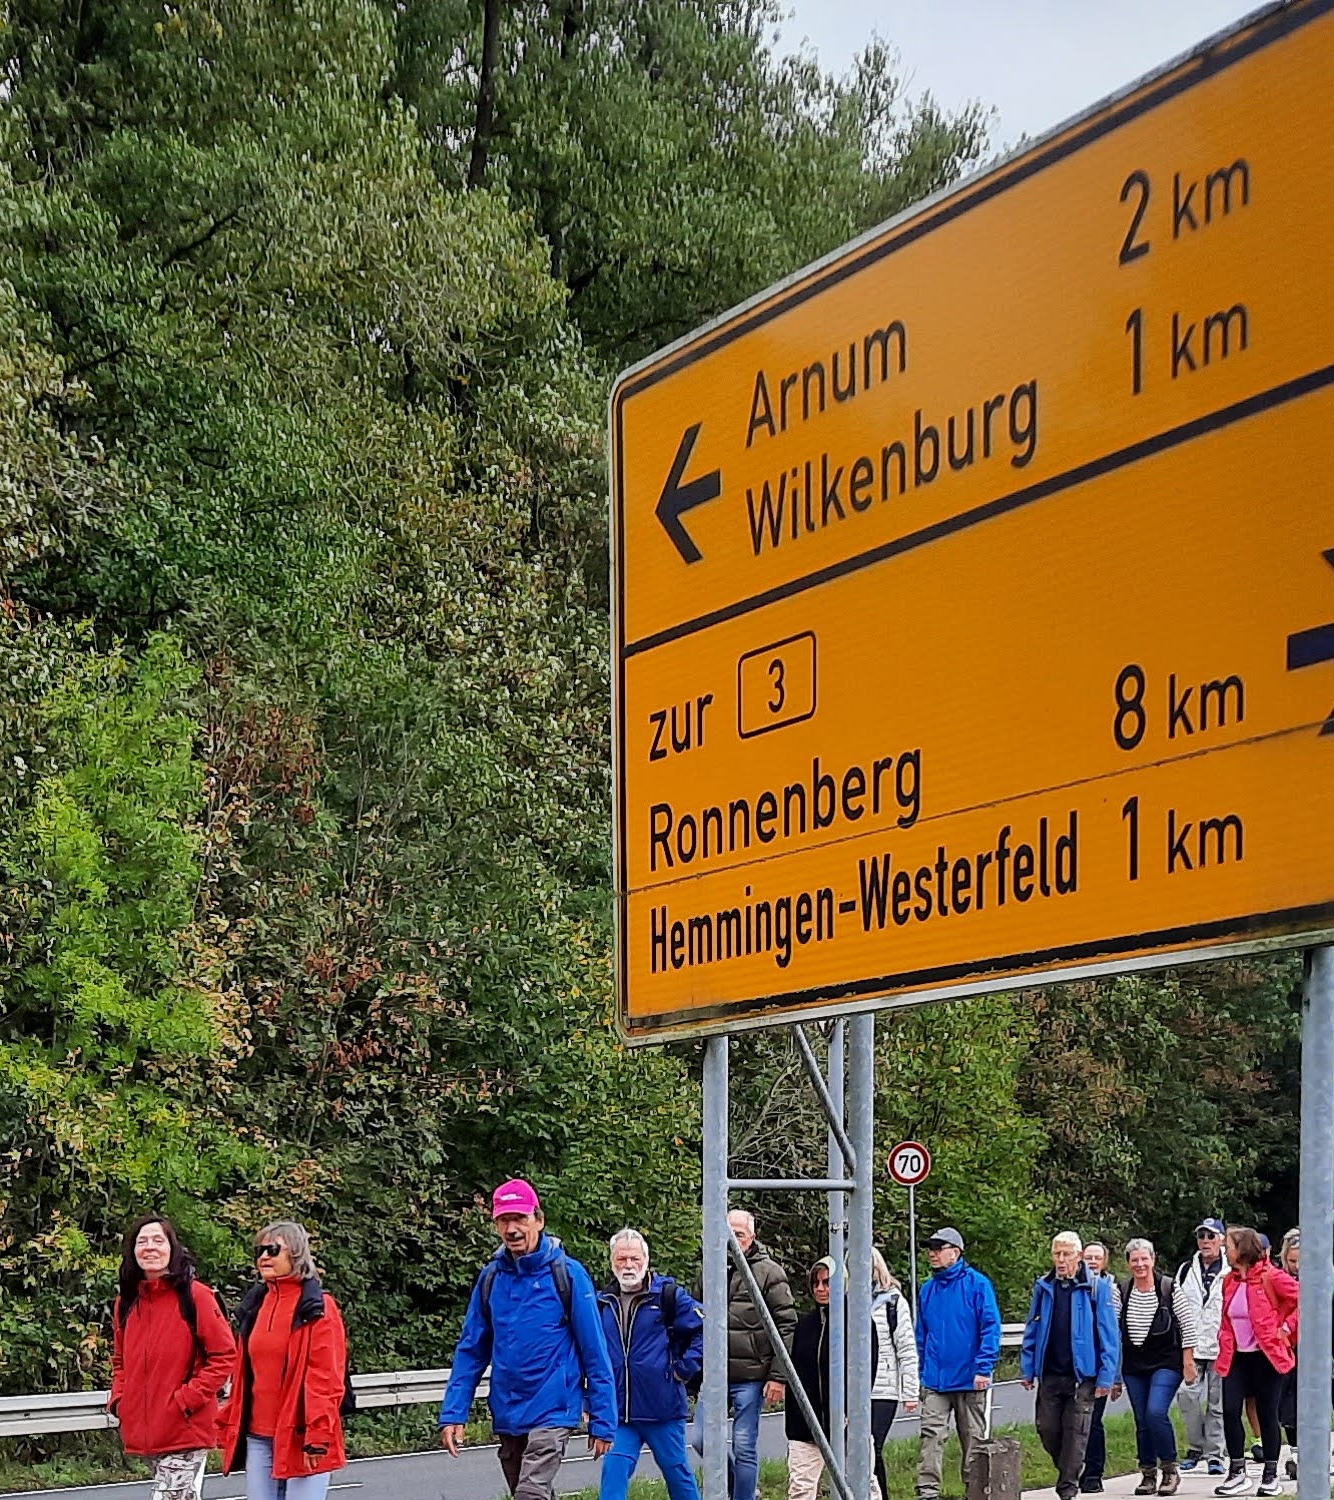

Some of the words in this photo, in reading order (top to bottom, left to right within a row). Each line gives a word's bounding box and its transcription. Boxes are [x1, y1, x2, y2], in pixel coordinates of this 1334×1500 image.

[745, 319, 908, 450] Arnum
[1117, 169, 1152, 268] 2
[1171, 157, 1251, 241] km
[745, 379, 1040, 557] Wilkenburg
[1124, 306, 1144, 397] 1
[1170, 302, 1250, 381] km
[648, 692, 715, 763] zur
[767, 658, 786, 714] 3
[649, 748, 922, 873] Ronnenberg
[1112, 663, 1148, 752] 8
[1167, 672, 1245, 741] km
[649, 809, 1079, 975] Hemmingen-Westerfeld
[1121, 795, 1140, 882] 1
[1166, 808, 1244, 875] km
[898, 1154, 921, 1174] 70
